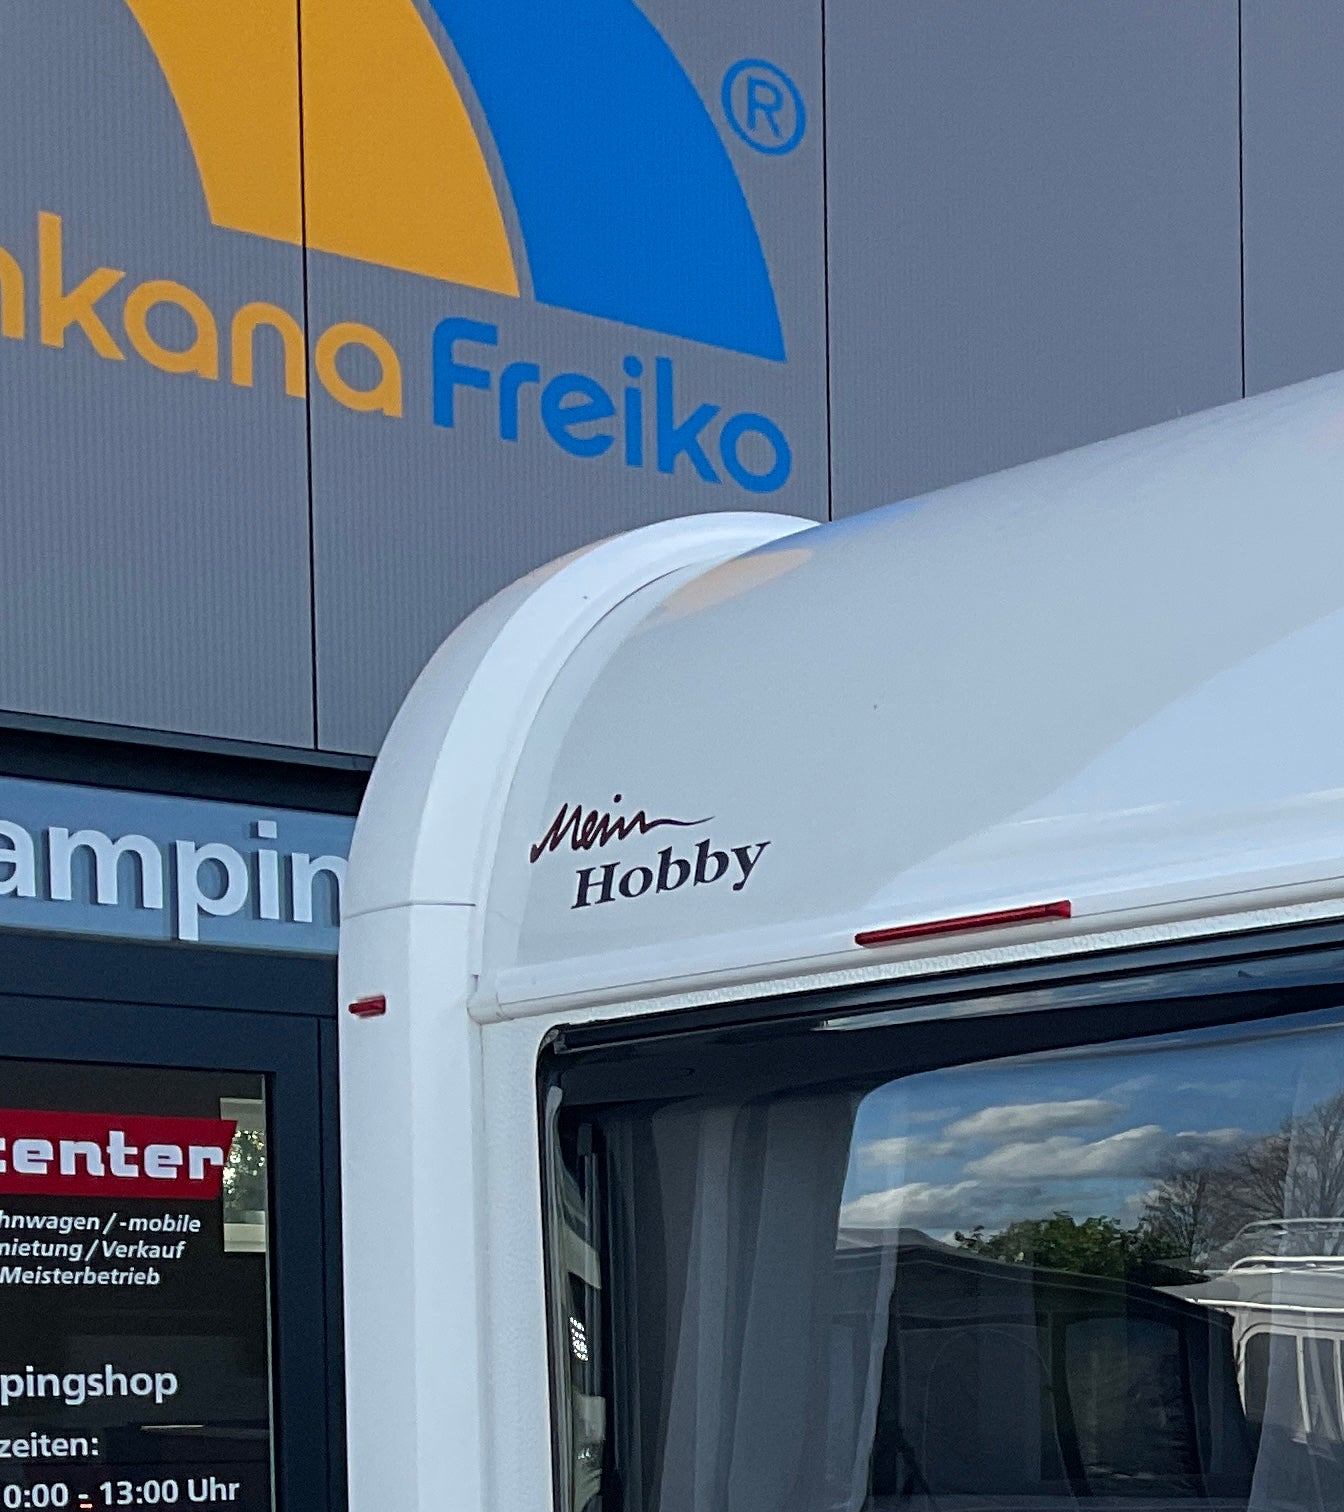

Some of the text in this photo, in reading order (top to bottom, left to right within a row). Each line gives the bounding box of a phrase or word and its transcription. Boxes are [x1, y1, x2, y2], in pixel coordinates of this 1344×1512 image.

[432, 316, 793, 493] Freiko
[530, 793, 714, 863] Mein
[570, 838, 771, 909] Hobby
[102, 1240, 187, 1259] Verkauf
[0, 1266, 161, 1285] Meisterbetrieb
[0, 1364, 178, 1405] pingshop
[99, 1479, 179, 1506] 13:00
[187, 1477, 240, 1502] Uhr
